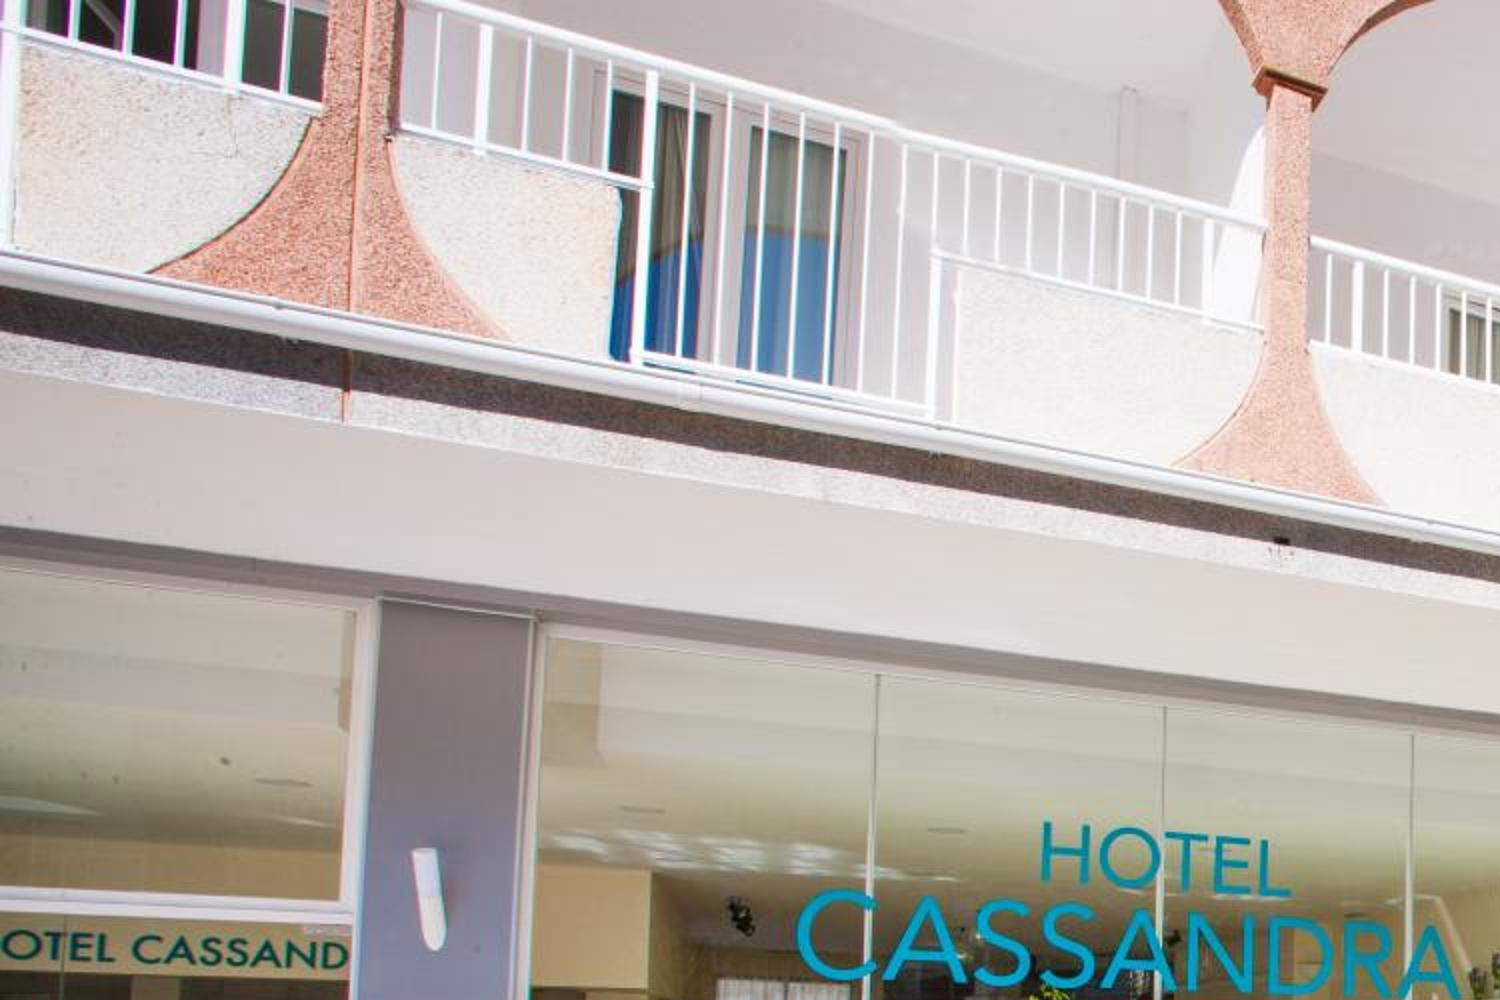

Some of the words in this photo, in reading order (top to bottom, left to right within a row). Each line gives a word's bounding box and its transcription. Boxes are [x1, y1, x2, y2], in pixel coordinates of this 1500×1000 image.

[1040, 821, 1292, 898] HOTEL
[0, 929, 116, 963] OTEL
[131, 934, 349, 970] CASSAND
[796, 887, 1462, 1000] CASSANDRA
